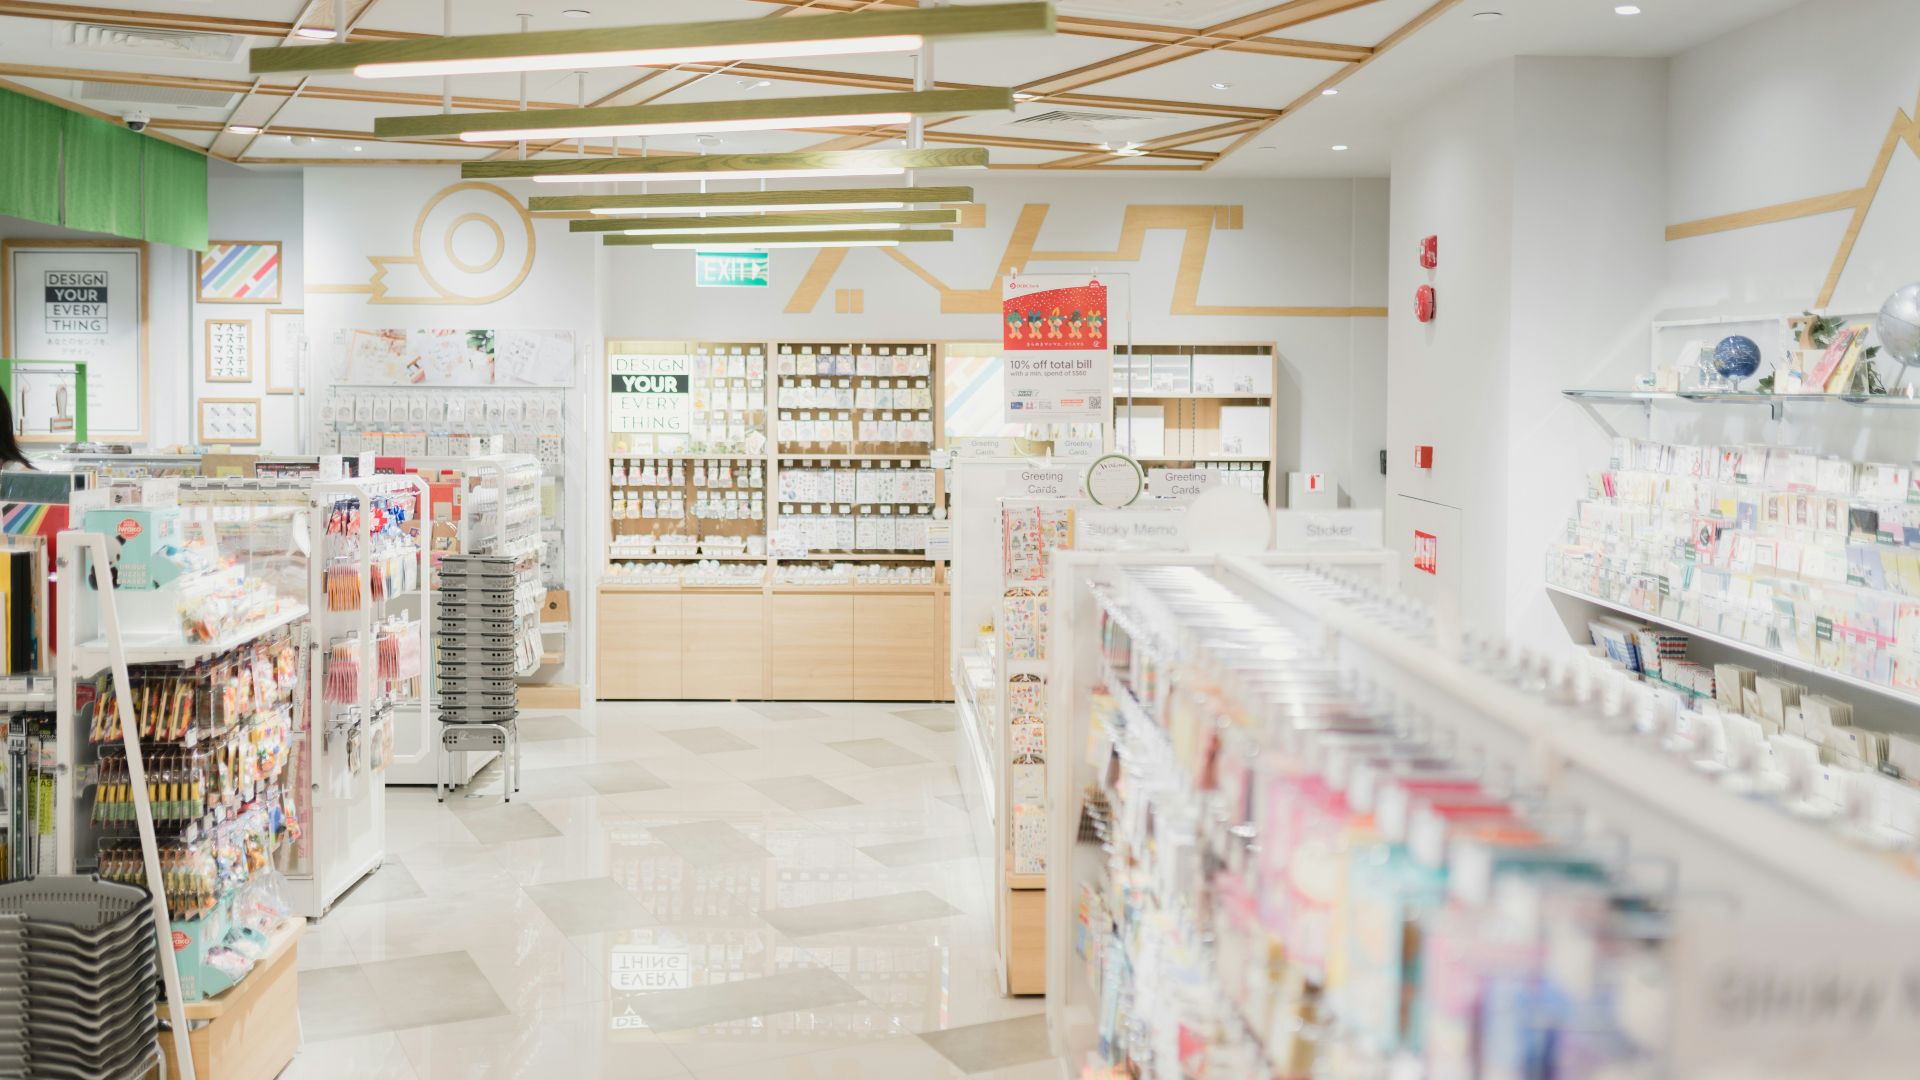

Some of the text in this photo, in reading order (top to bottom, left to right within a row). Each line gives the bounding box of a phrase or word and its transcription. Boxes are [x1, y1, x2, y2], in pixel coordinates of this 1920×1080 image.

[704, 256, 746, 281] EXIT
[49, 274, 104, 286] DESIGN
[54, 288, 98, 302] YOUR
[53, 304, 100, 316] EVERY
[52, 320, 102, 331] THING
[616, 358, 684, 371] DESIGN
[1010, 359, 1092, 369] 10% off total bill
[1044, 370, 1063, 378] spend
[621, 375, 678, 393] YOUR
[621, 398, 680, 410] EVERY
[619, 416, 680, 429] THING
[971, 440, 999, 448] Greeting
[1064, 439, 1093, 448] Greeting
[1021, 470, 1064, 482] Greeting
[1165, 471, 1207, 483] Greeting
[1027, 484, 1057, 494] Cards
[1171, 485, 1200, 495] Cards
[1088, 522, 1178, 538] Sticky Memo
[1306, 523, 1353, 537] Sticker
